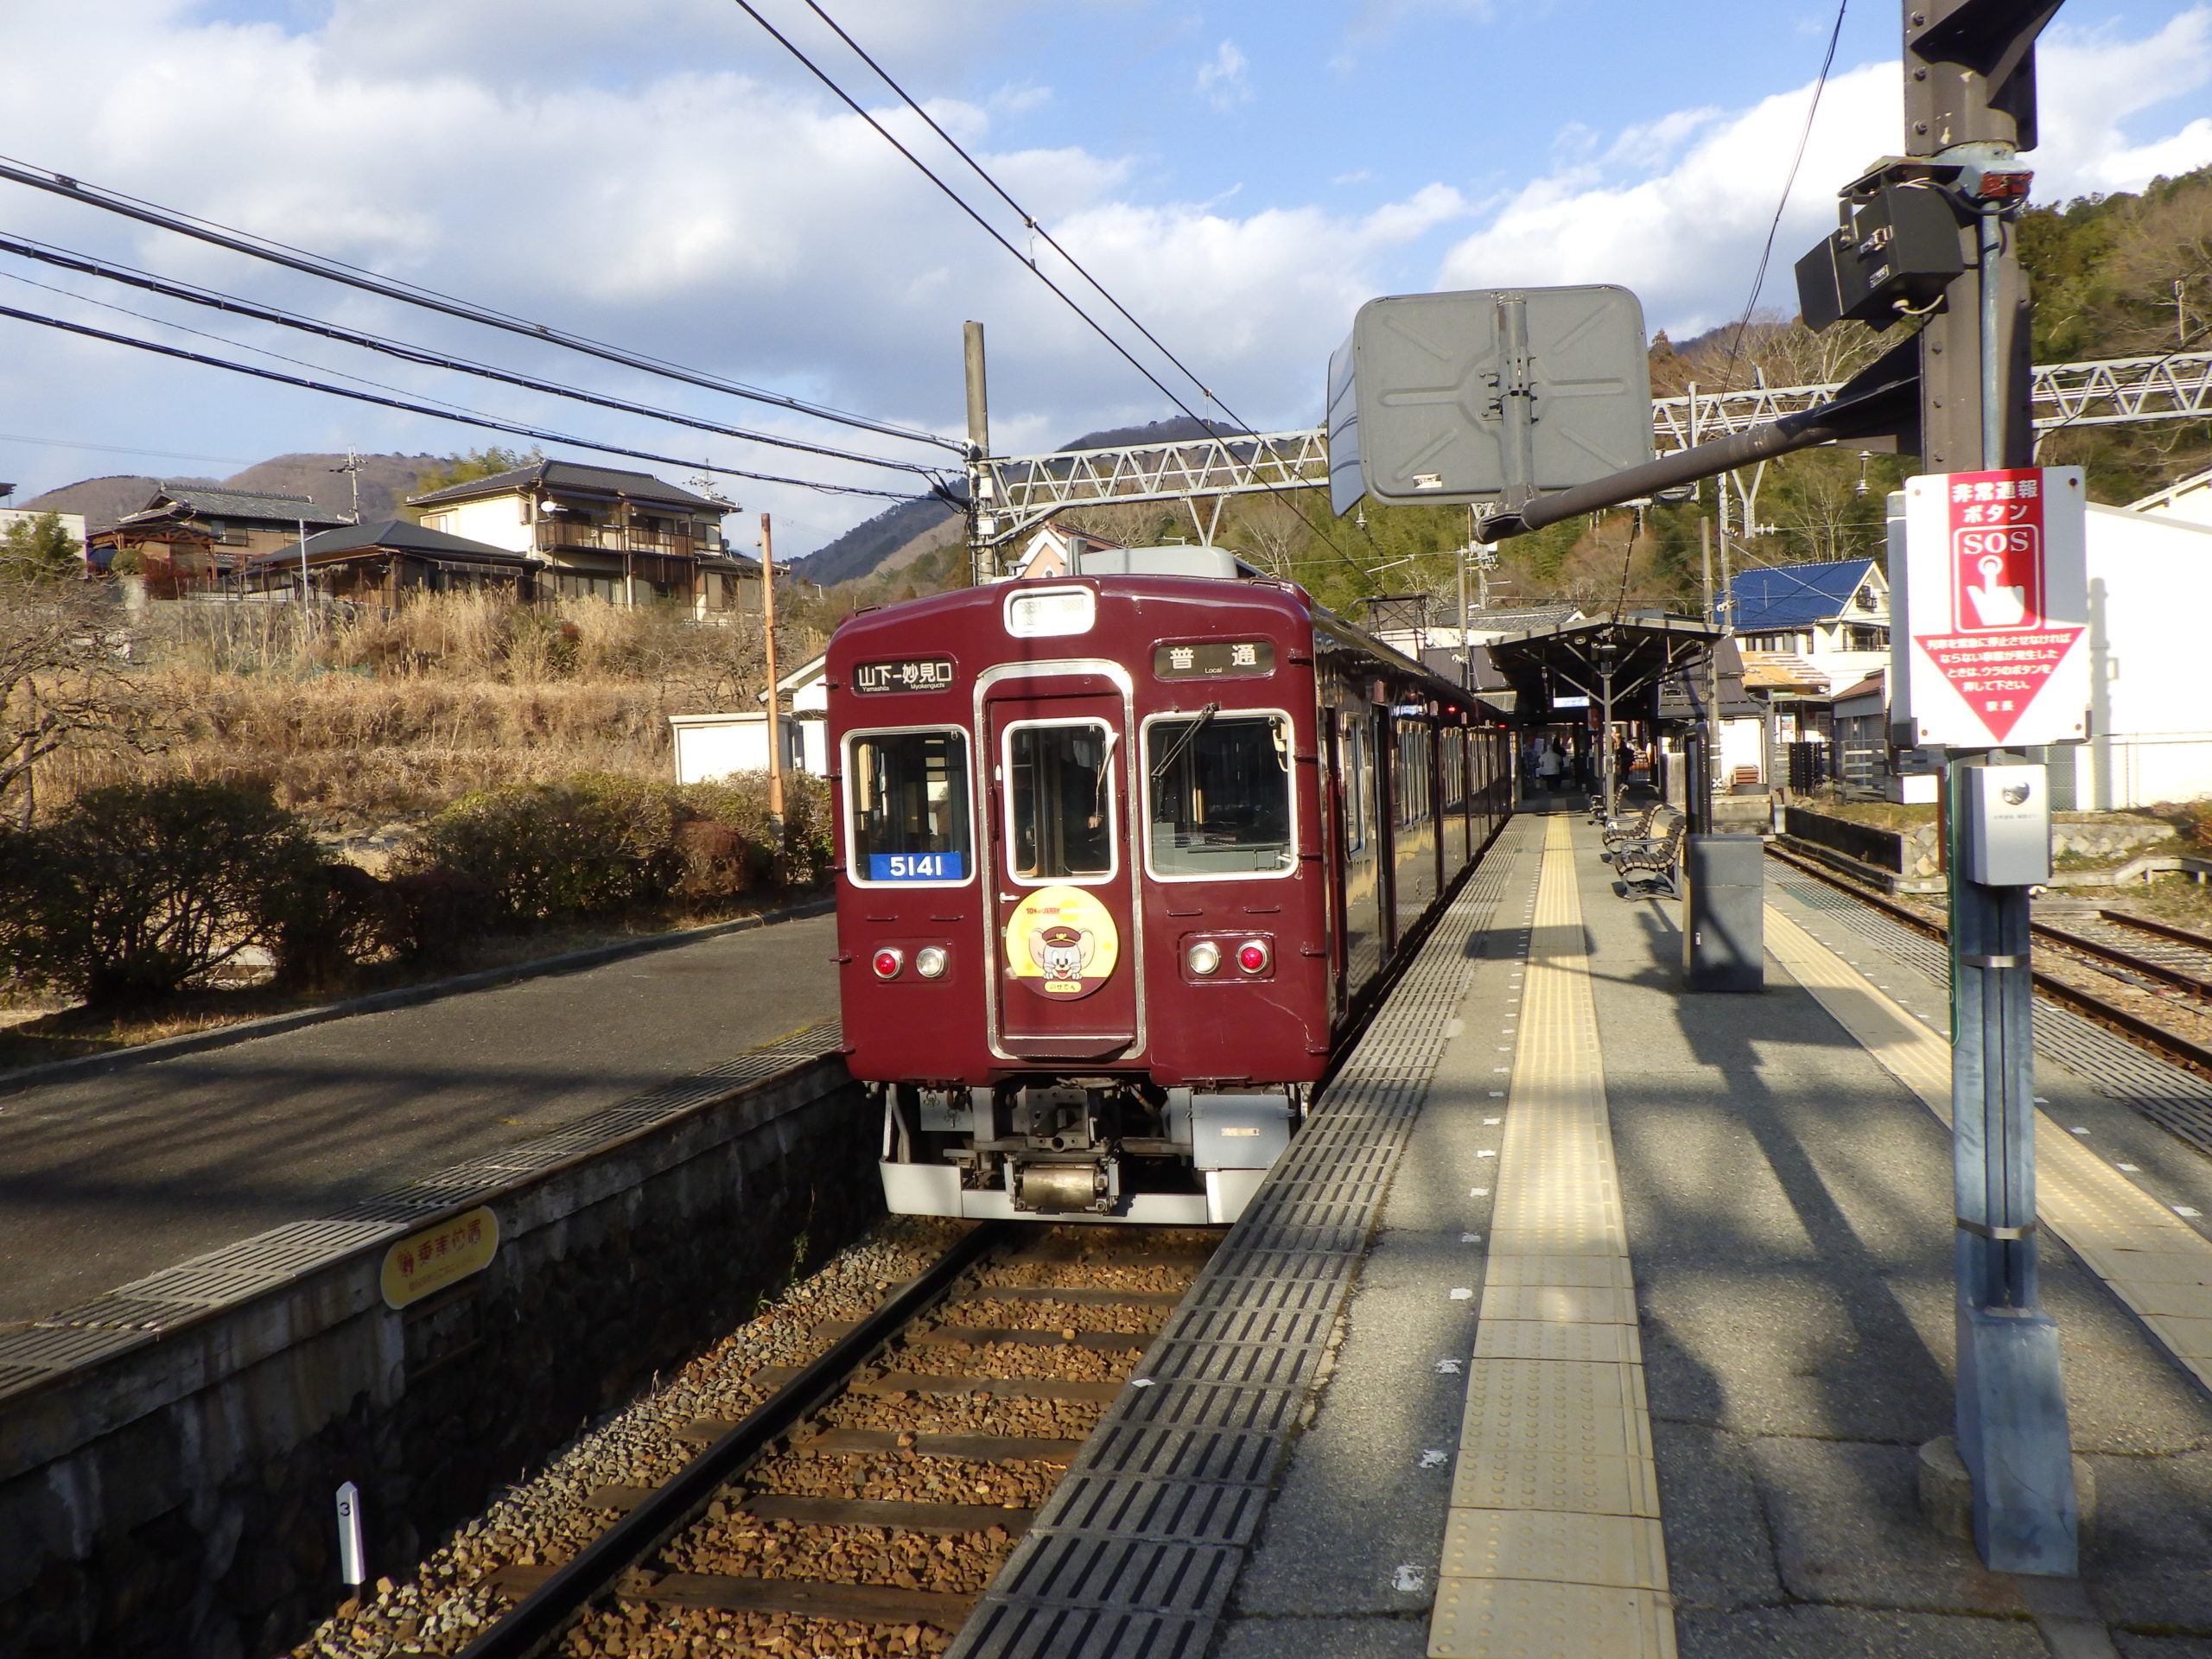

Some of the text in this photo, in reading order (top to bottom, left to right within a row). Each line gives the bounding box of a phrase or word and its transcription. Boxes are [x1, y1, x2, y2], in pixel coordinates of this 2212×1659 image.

[1952, 479, 2038, 503] 非常通報
[1962, 505, 2028, 524] ボタン
[1963, 531, 2029, 554] SOS
[1940, 649, 2059, 664] ならない事態が発生した
[1947, 664, 2052, 678] ときは、ウラのボタンを
[910, 682, 945, 690] Myokenguchi
[1962, 679, 2031, 692] 押して下さい。
[889, 855, 942, 877] 5141
[340, 1502, 351, 1516] 3
